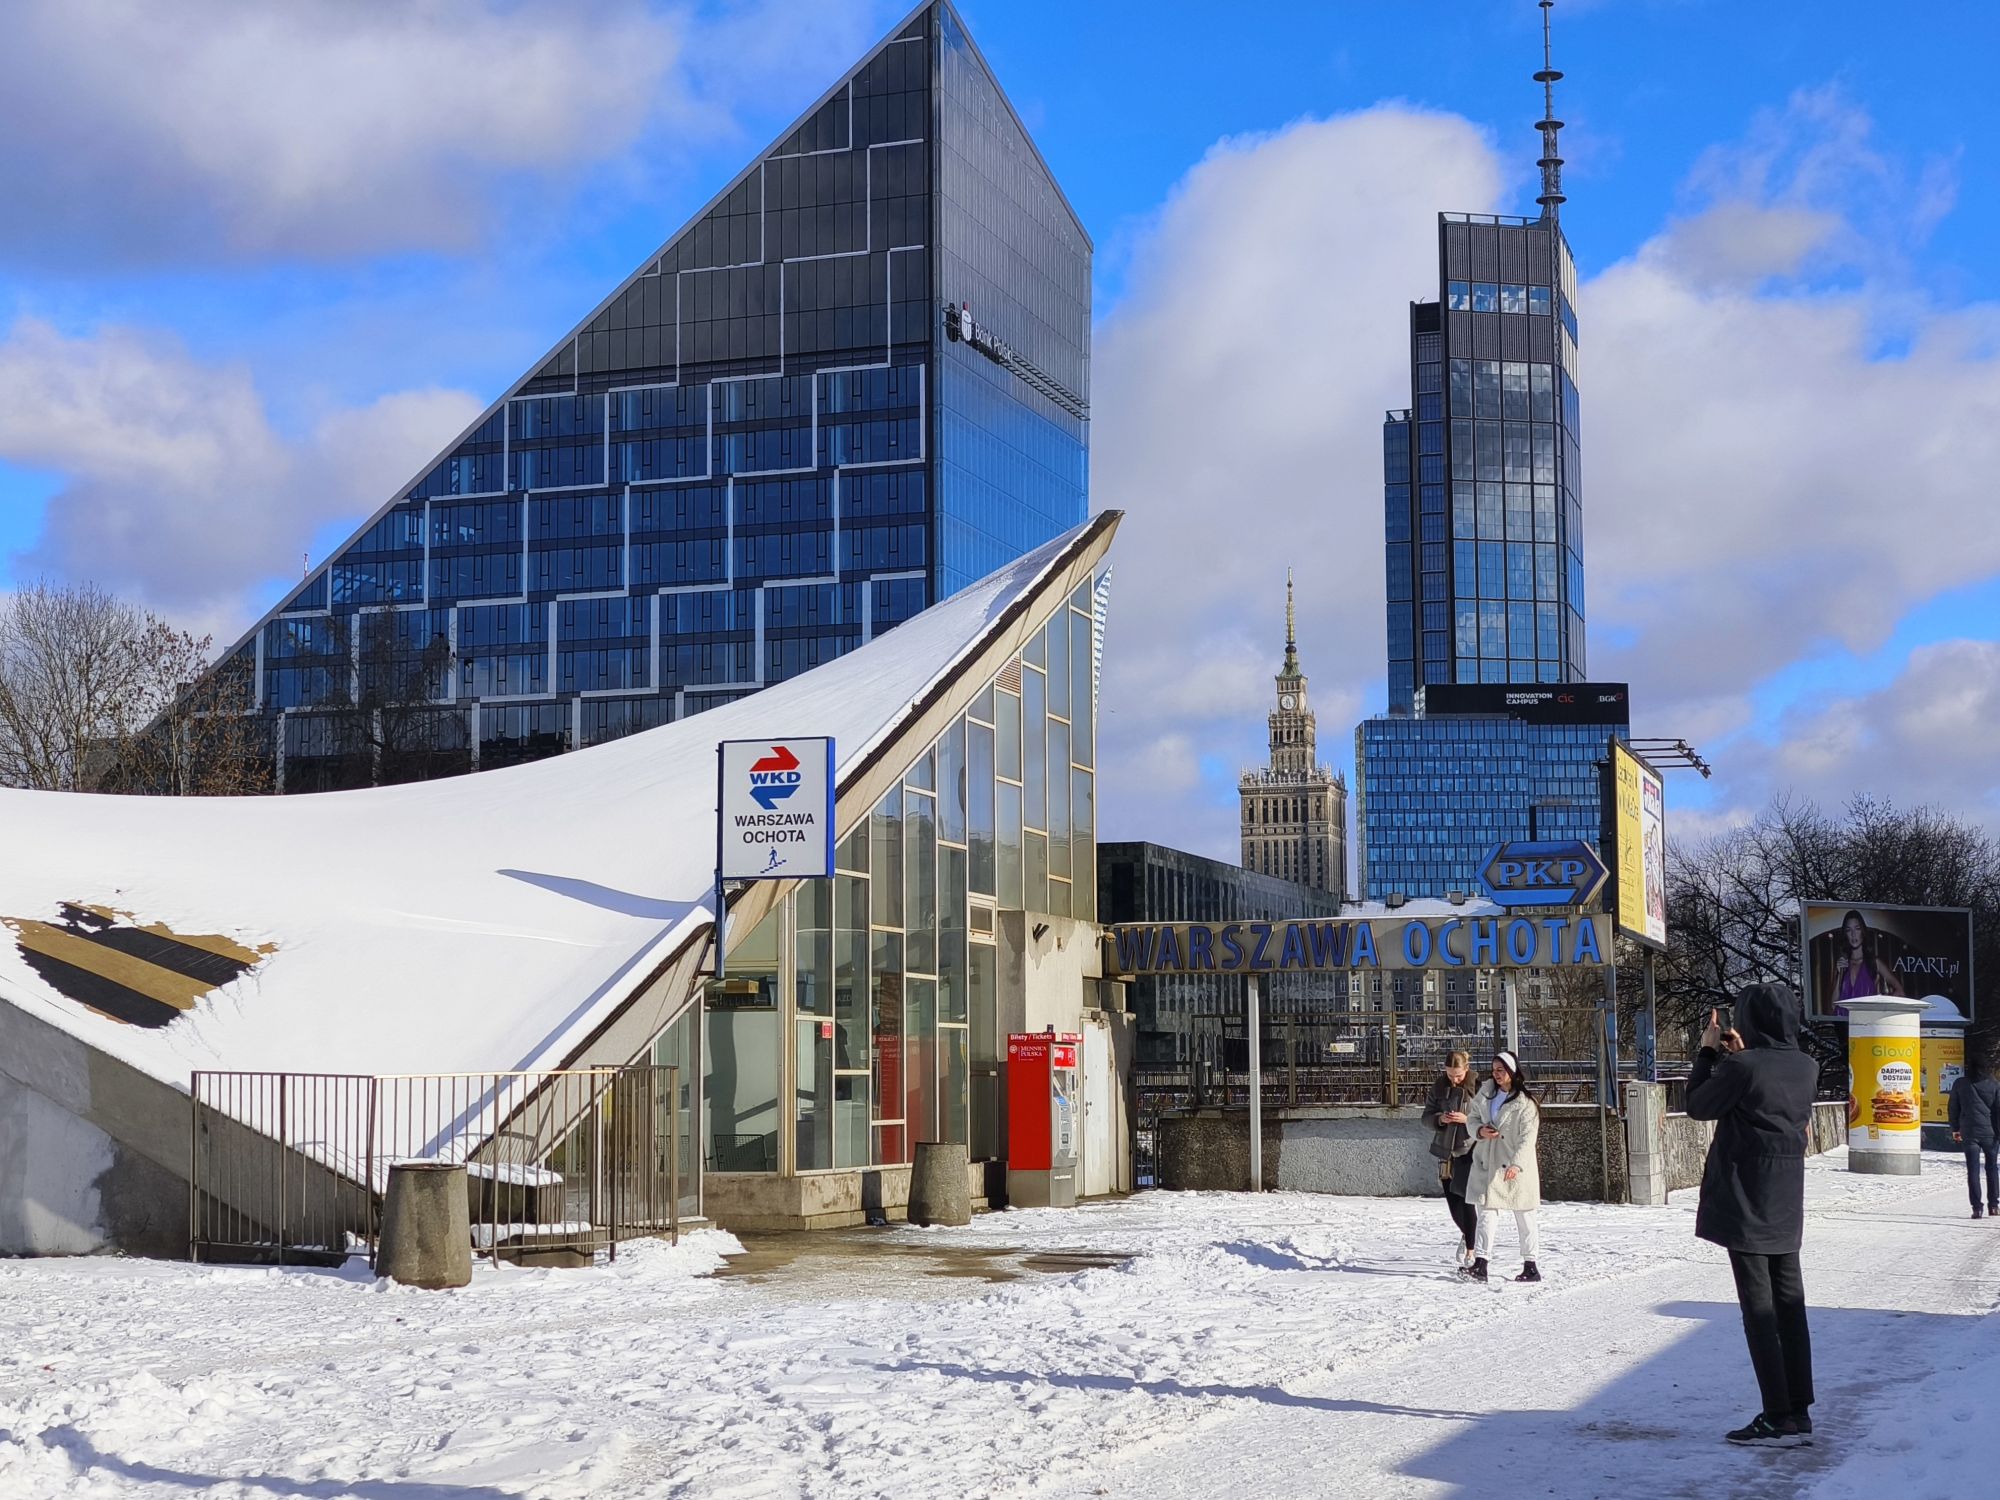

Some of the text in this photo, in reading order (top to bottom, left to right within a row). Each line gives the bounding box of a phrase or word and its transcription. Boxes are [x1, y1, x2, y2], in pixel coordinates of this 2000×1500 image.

[749, 771, 802, 785] WKD
[734, 813, 815, 827] WARSZAWA
[742, 830, 806, 844] OCHOTA
[1496, 859, 1587, 889] PKP
[1114, 920, 1381, 972] WARSZAWA
[1402, 914, 1603, 967] OCHOTA
[1892, 956, 1960, 979] APART.pl
[1871, 1044, 1913, 1057] Glovo
